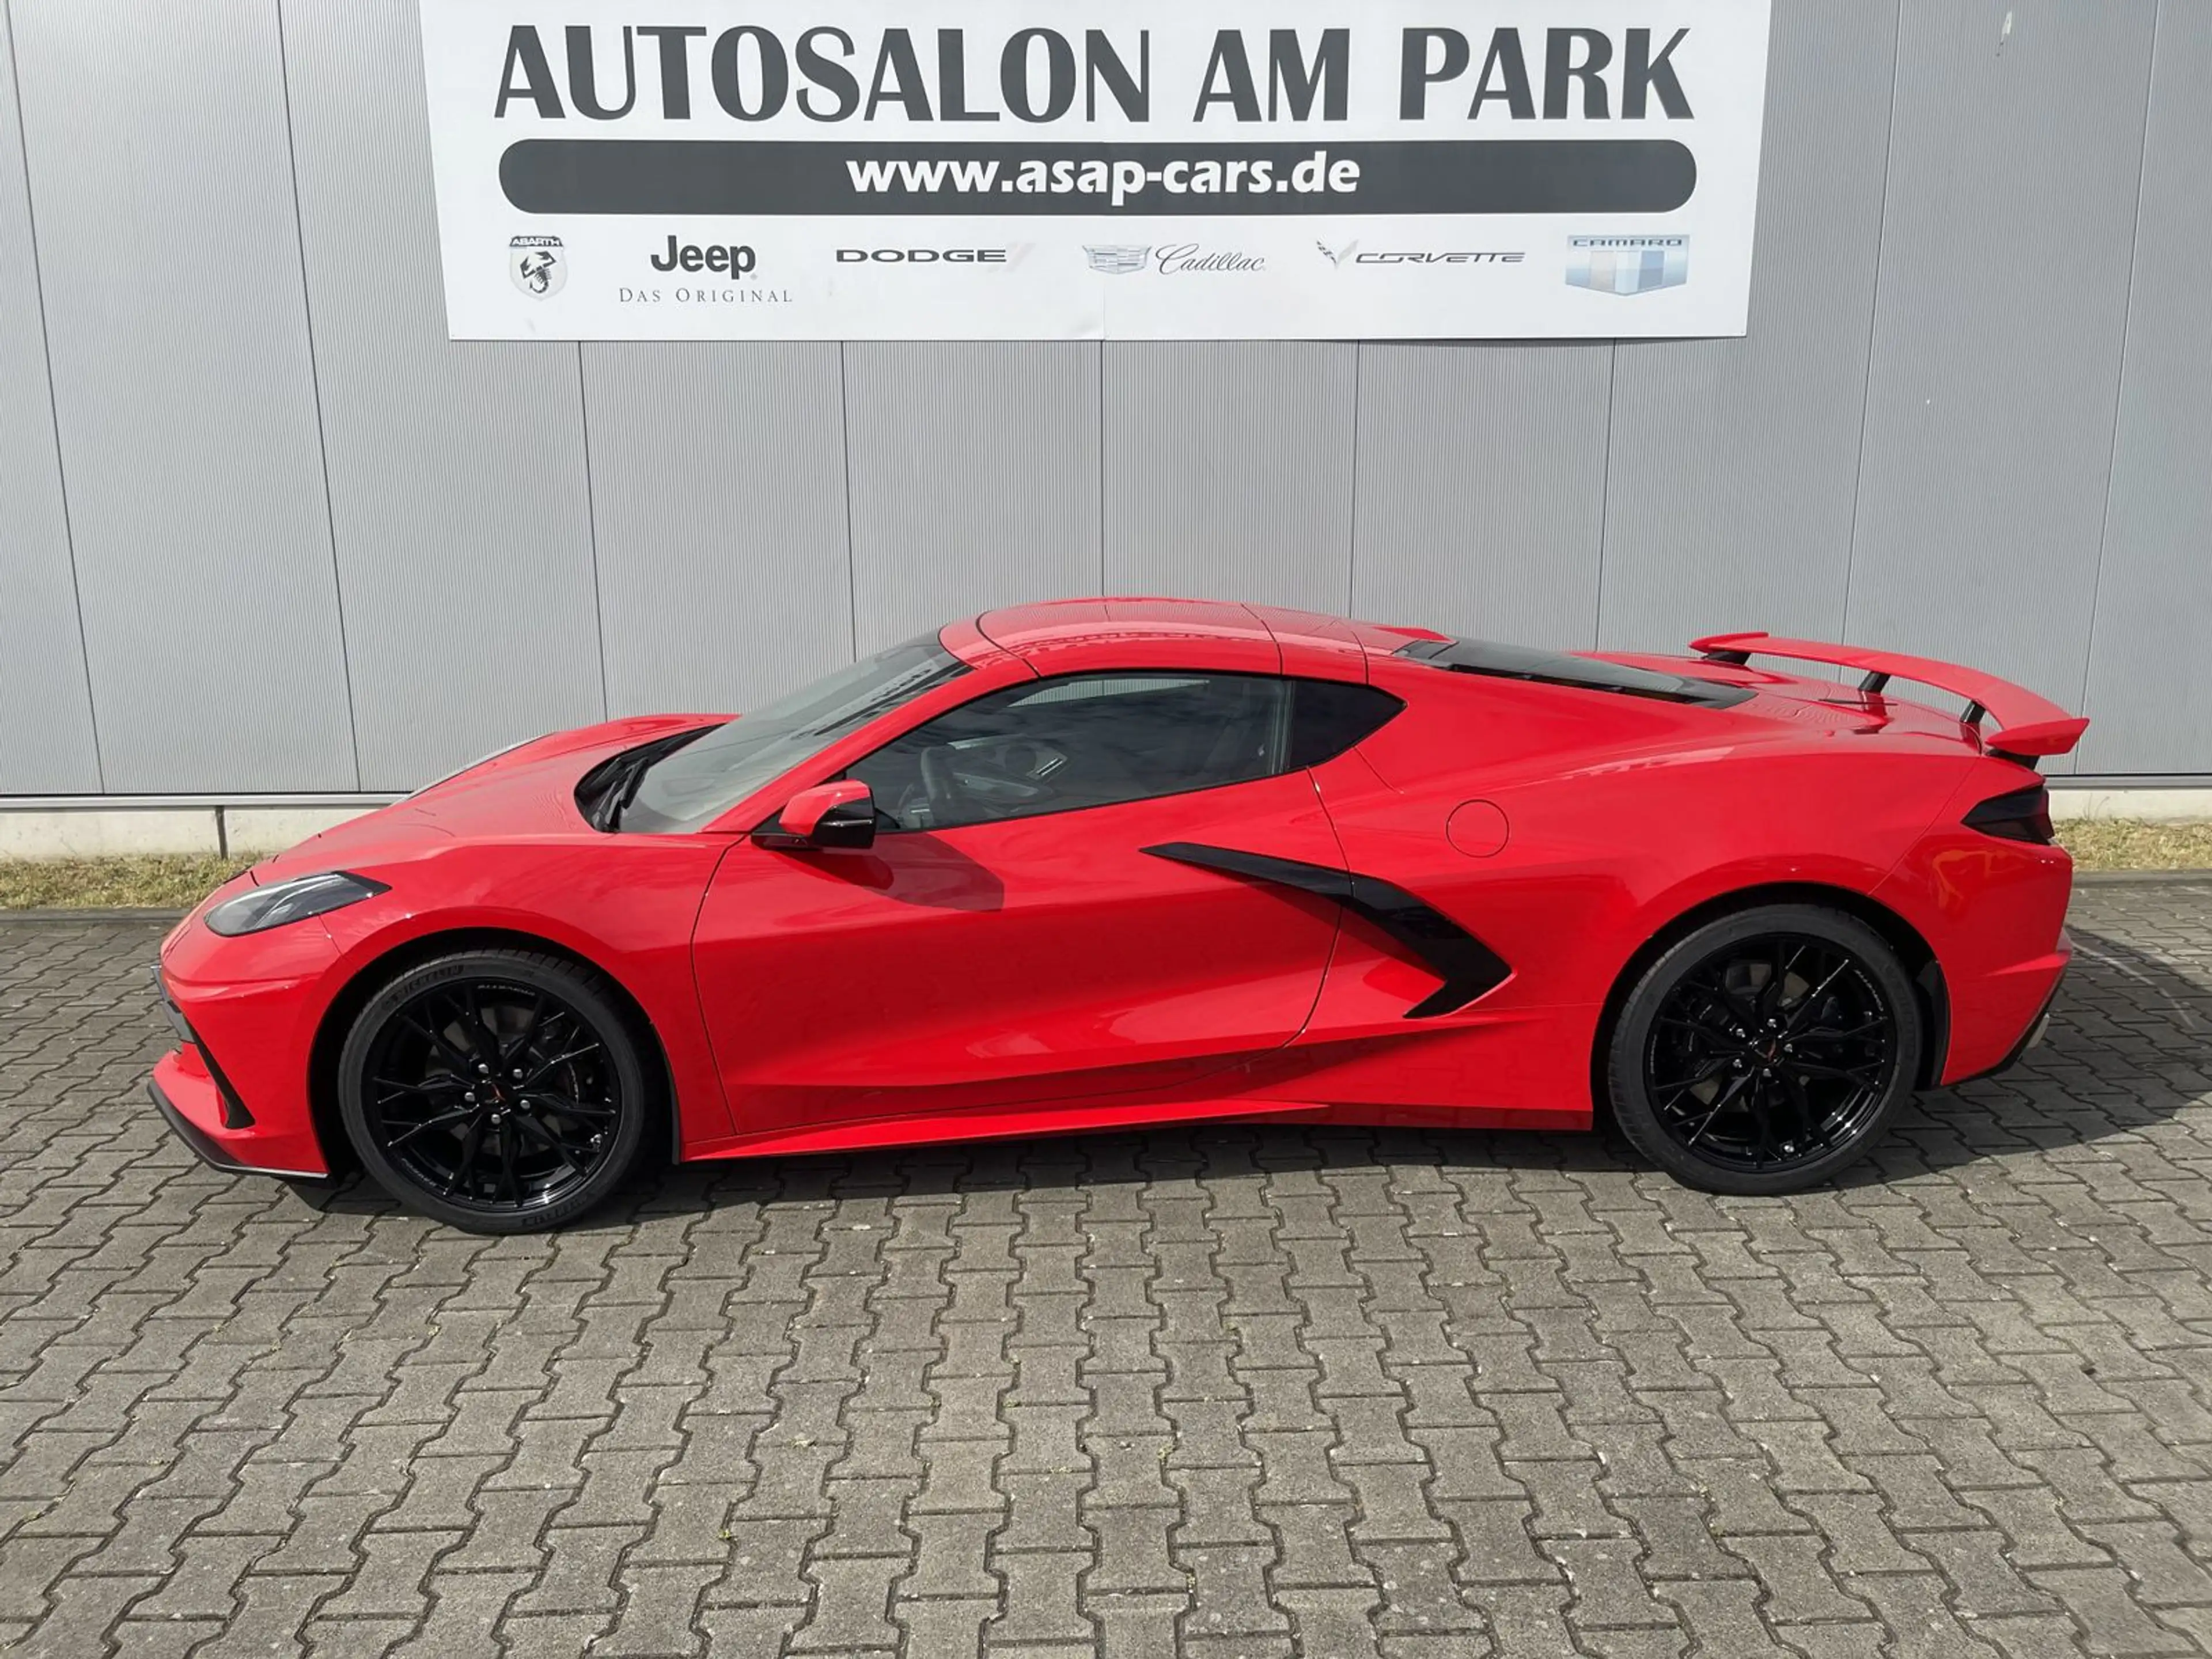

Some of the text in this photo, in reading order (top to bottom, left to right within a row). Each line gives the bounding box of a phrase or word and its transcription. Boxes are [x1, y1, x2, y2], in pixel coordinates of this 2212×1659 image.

[494, 25, 1695, 123] AUTOSALON AM PARK
[846, 150, 1360, 206] www.asap-cars.de
[510, 236, 563, 247] ABARTH
[650, 234, 756, 280] Jeep
[836, 249, 1007, 263] DODGE
[1356, 252, 1525, 263] CORVETTE
[1155, 243, 1265, 275] Cadillac
